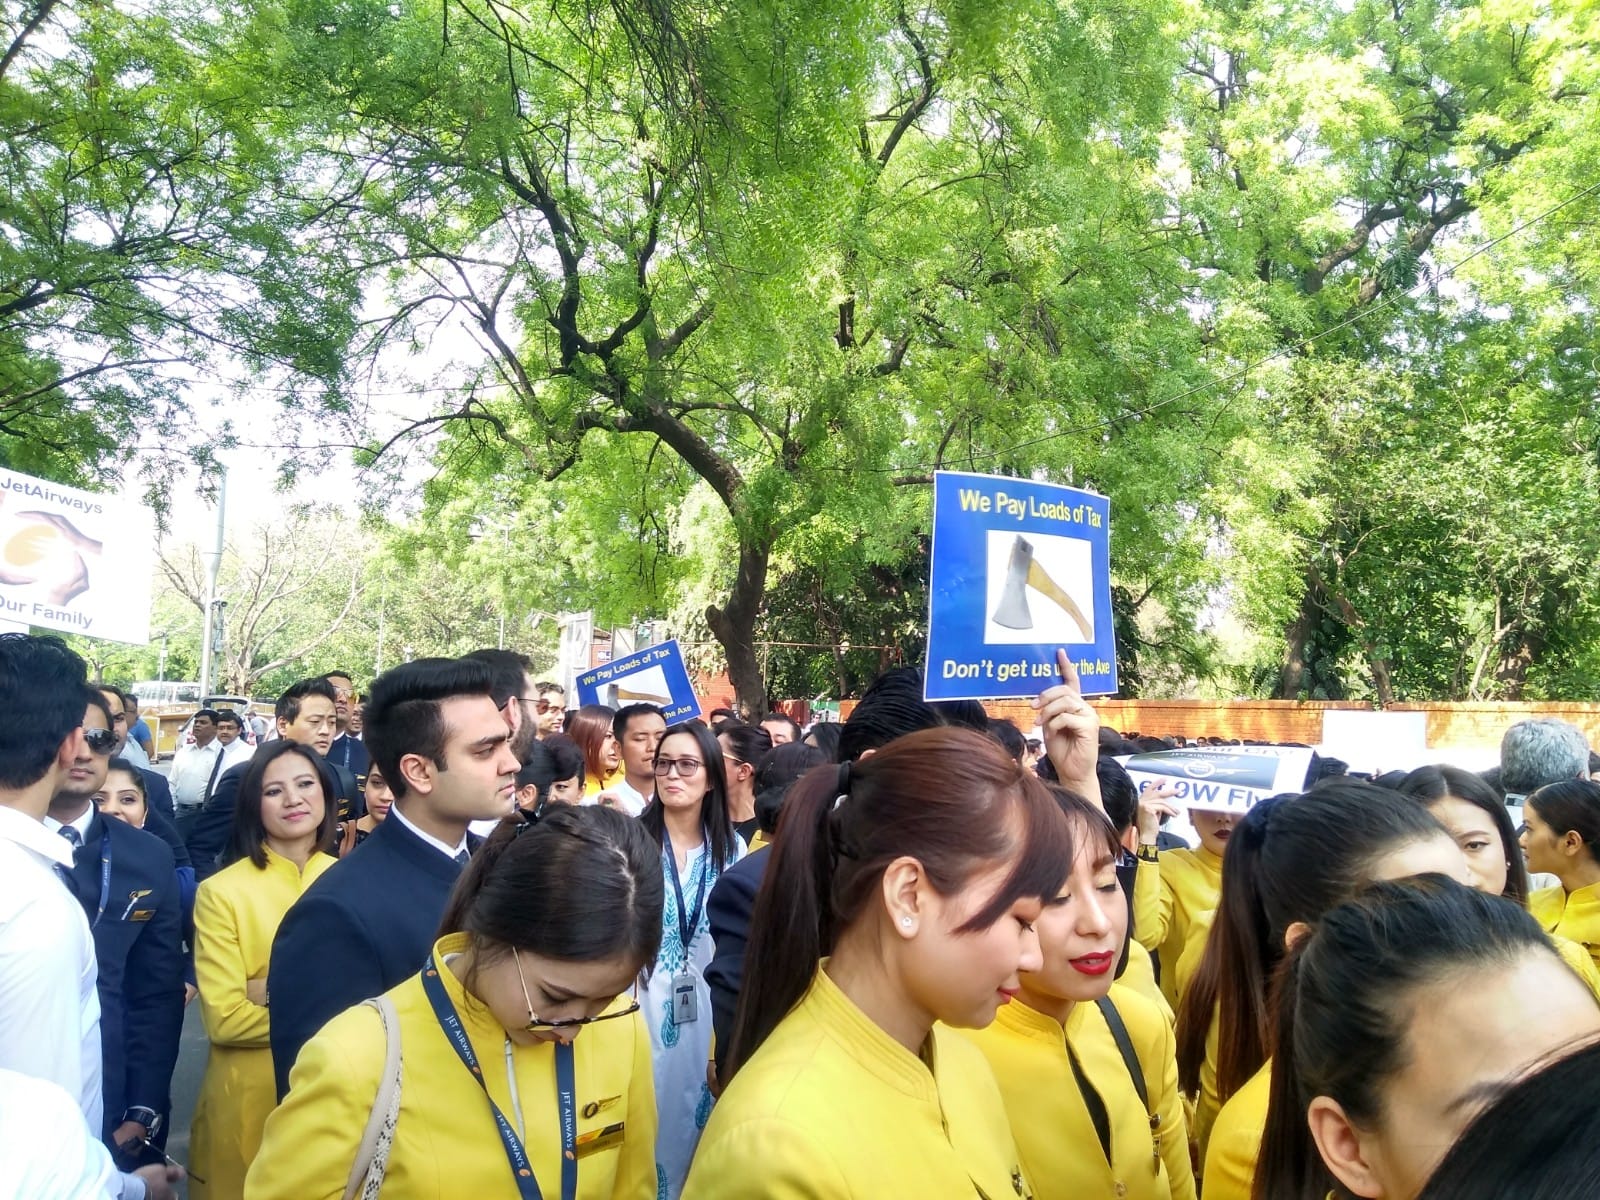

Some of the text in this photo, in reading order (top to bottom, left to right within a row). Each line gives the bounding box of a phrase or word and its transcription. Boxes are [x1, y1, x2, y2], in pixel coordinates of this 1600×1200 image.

[1, 478, 103, 514] JetAirways
[959, 488, 1102, 528] We Pay Loads of Tax
[32, 603, 93, 629] Family
[583, 648, 671, 686] We Pay Loads of Tax
[942, 659, 994, 679] Don't
[997, 660, 1028, 682] get
[1031, 663, 1052, 678] us
[1080, 657, 1095, 676] the
[1095, 657, 1111, 676] Axe
[677, 705, 692, 716] Axe
[1174, 781, 1220, 803] 9W
[444, 1015, 476, 1066] JET AIRWAYS
[561, 1091, 573, 1149] JET AIRWAYS
[496, 1114, 525, 1168] JET AIRWAYS
